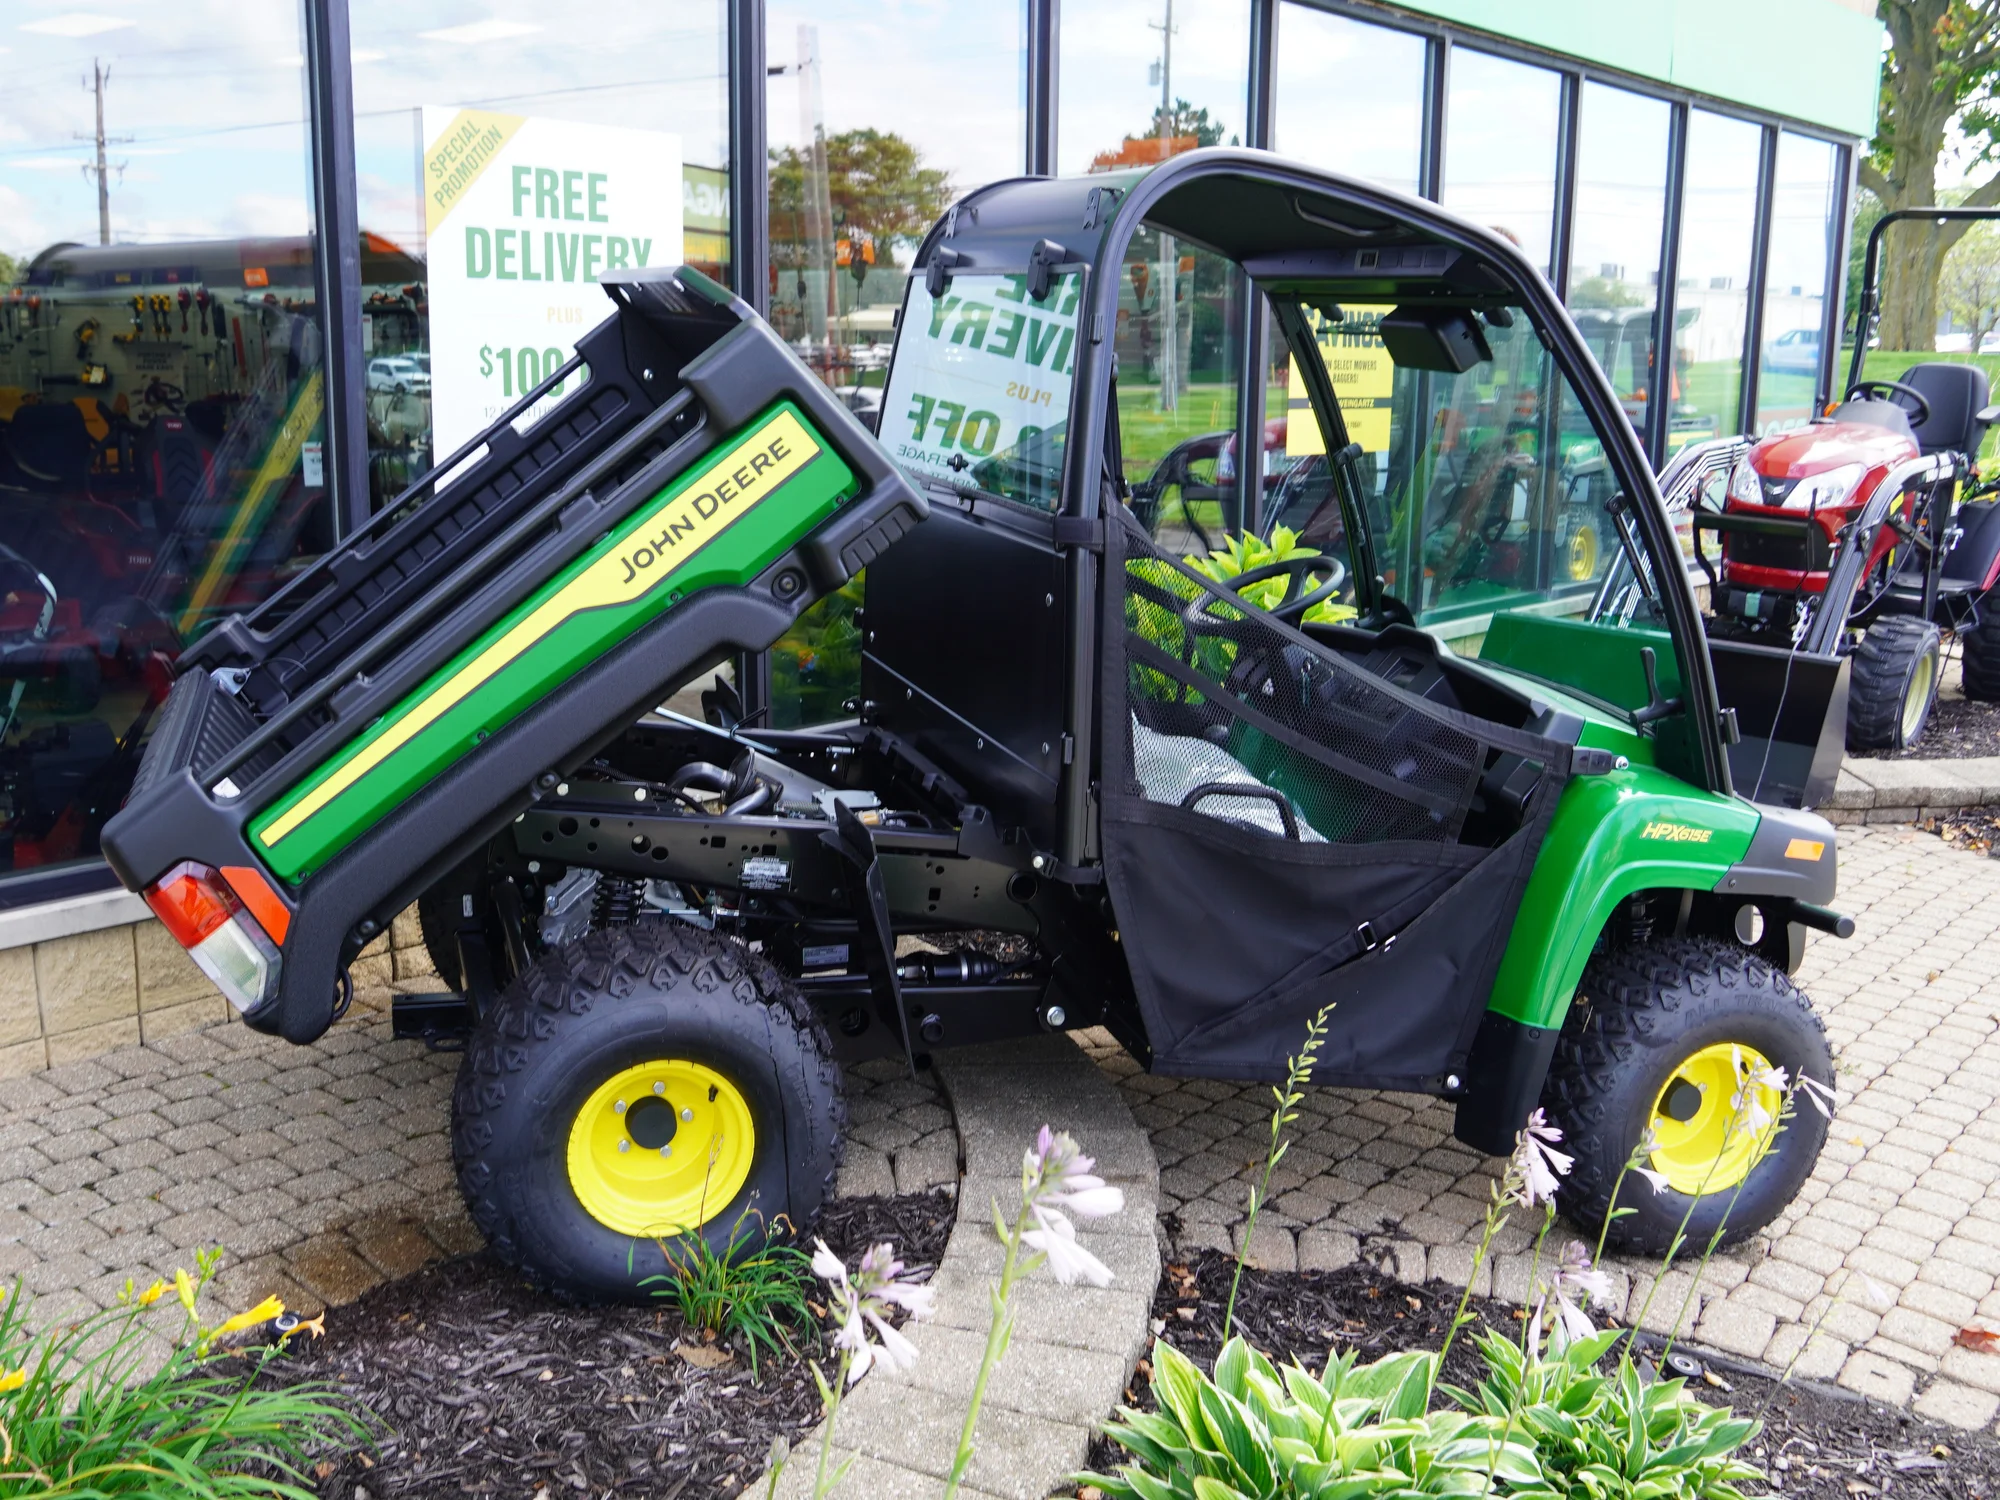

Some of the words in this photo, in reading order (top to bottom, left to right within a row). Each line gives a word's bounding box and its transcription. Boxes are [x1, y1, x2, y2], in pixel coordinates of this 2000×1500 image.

[429, 119, 481, 179] SPECIAL
[433, 124, 503, 208] PROMOTION
[511, 165, 609, 223] FREE
[464, 226, 653, 284] DELIVERY
[547, 306, 583, 324] PLUS
[479, 344, 565, 398] $100
[1333, 359, 1353, 370] SELECT
[1353, 360, 1377, 371] MOWERS
[485, 405, 496, 418] 12
[620, 514, 696, 584] JOHN
[691, 437, 792, 520] DEERE
[1642, 821, 1714, 843] HPX615E
